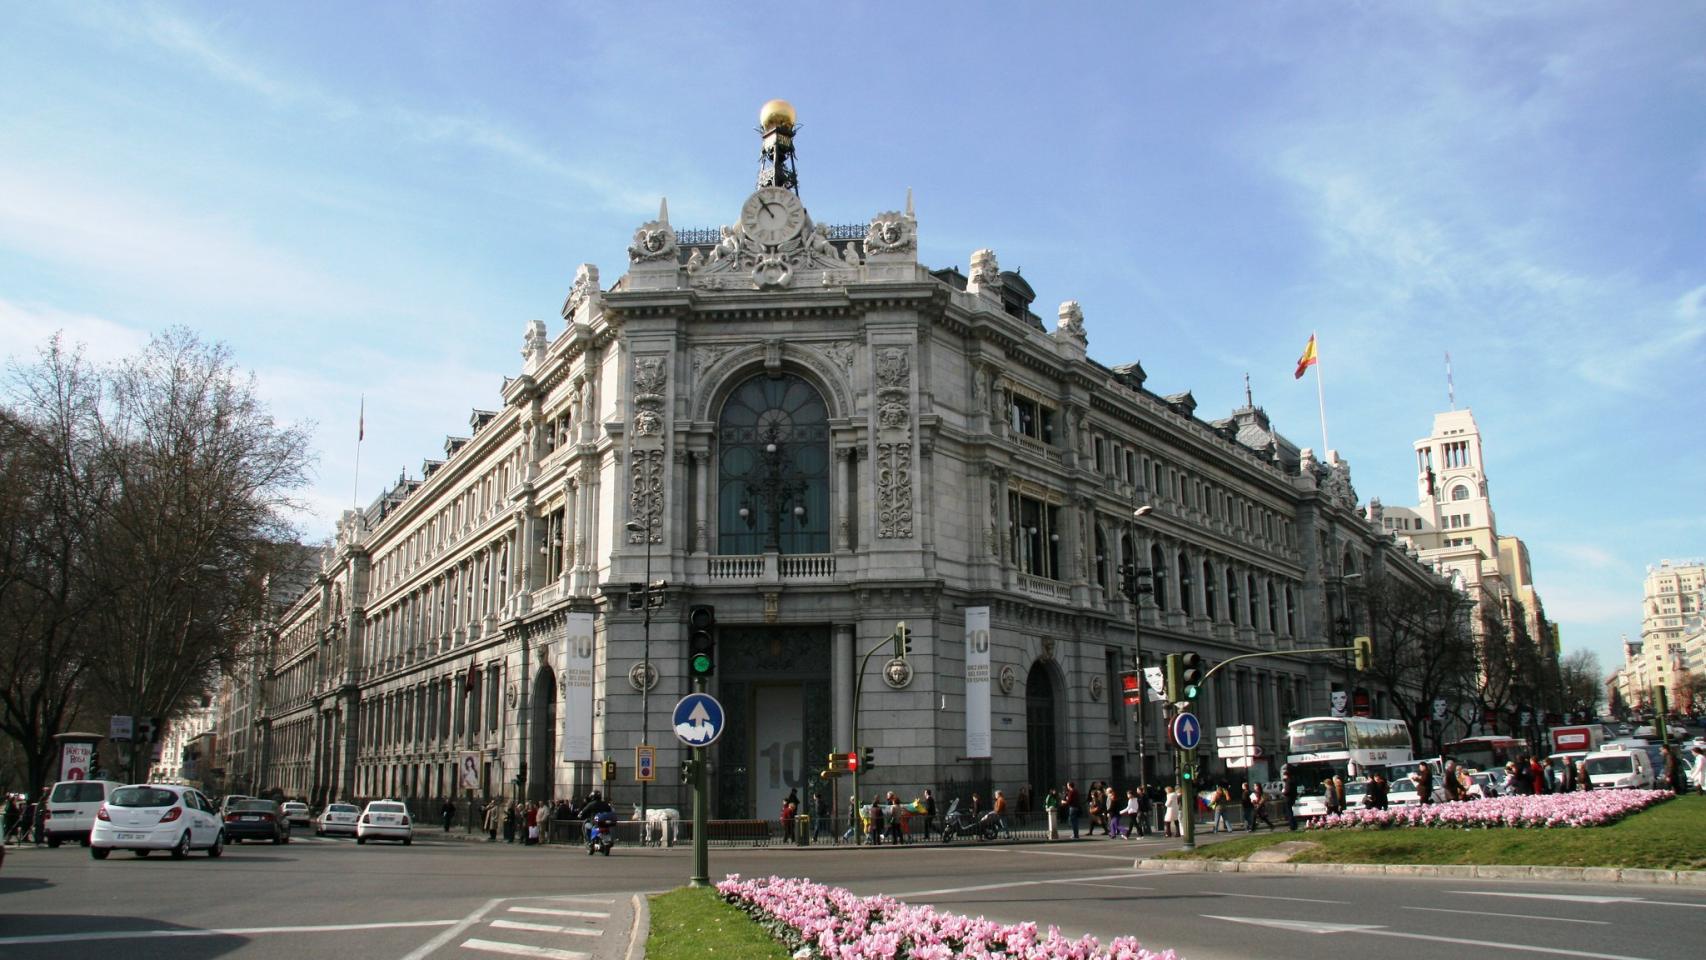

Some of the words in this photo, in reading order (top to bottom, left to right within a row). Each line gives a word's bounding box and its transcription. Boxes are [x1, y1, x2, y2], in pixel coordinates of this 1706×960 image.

[568, 635, 591, 658] 10
[966, 630, 988, 653] 10
[760, 742, 806, 788] 10
